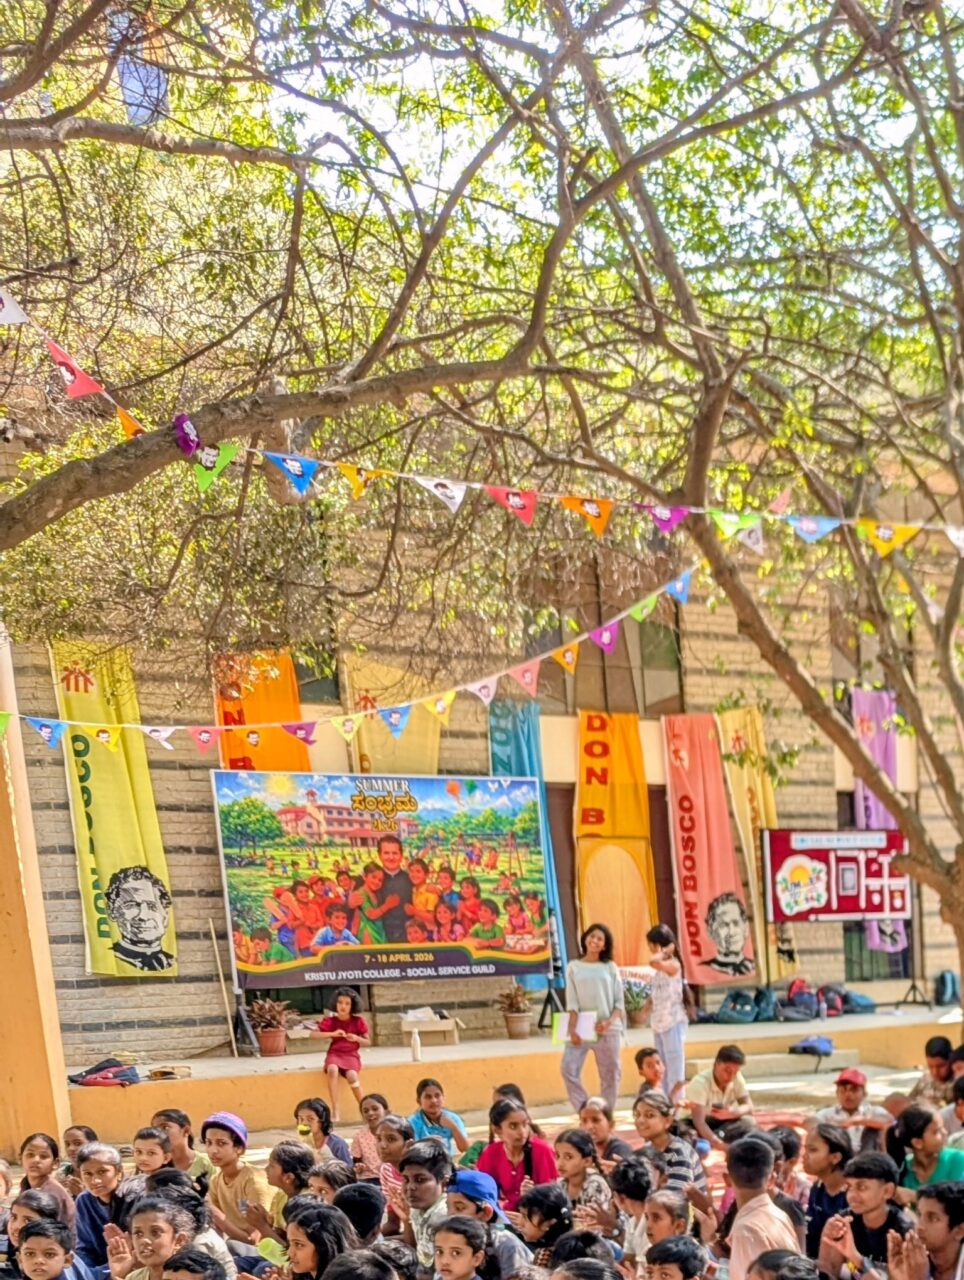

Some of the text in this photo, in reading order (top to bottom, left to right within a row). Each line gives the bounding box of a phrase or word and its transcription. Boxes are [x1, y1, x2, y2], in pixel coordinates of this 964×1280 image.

[583, 714, 610, 786] DON
[355, 778, 411, 792] SUMMER
[581, 807, 606, 838] B
[678, 794, 703, 958] DON BOSCO
[364, 954, 369, 963] 7
[377, 954, 387, 963] 18
[388, 953, 412, 962] APRIL
[414, 952, 435, 962] 2026
[304, 971, 336, 982] KRISTU
[337, 970, 362, 981] JYOTI
[362, 968, 401, 979] COLLEGE
[406, 966, 437, 977] SOCIAL
[438, 965, 471, 976] SERVICE
[472, 964, 496, 974] GUILD
